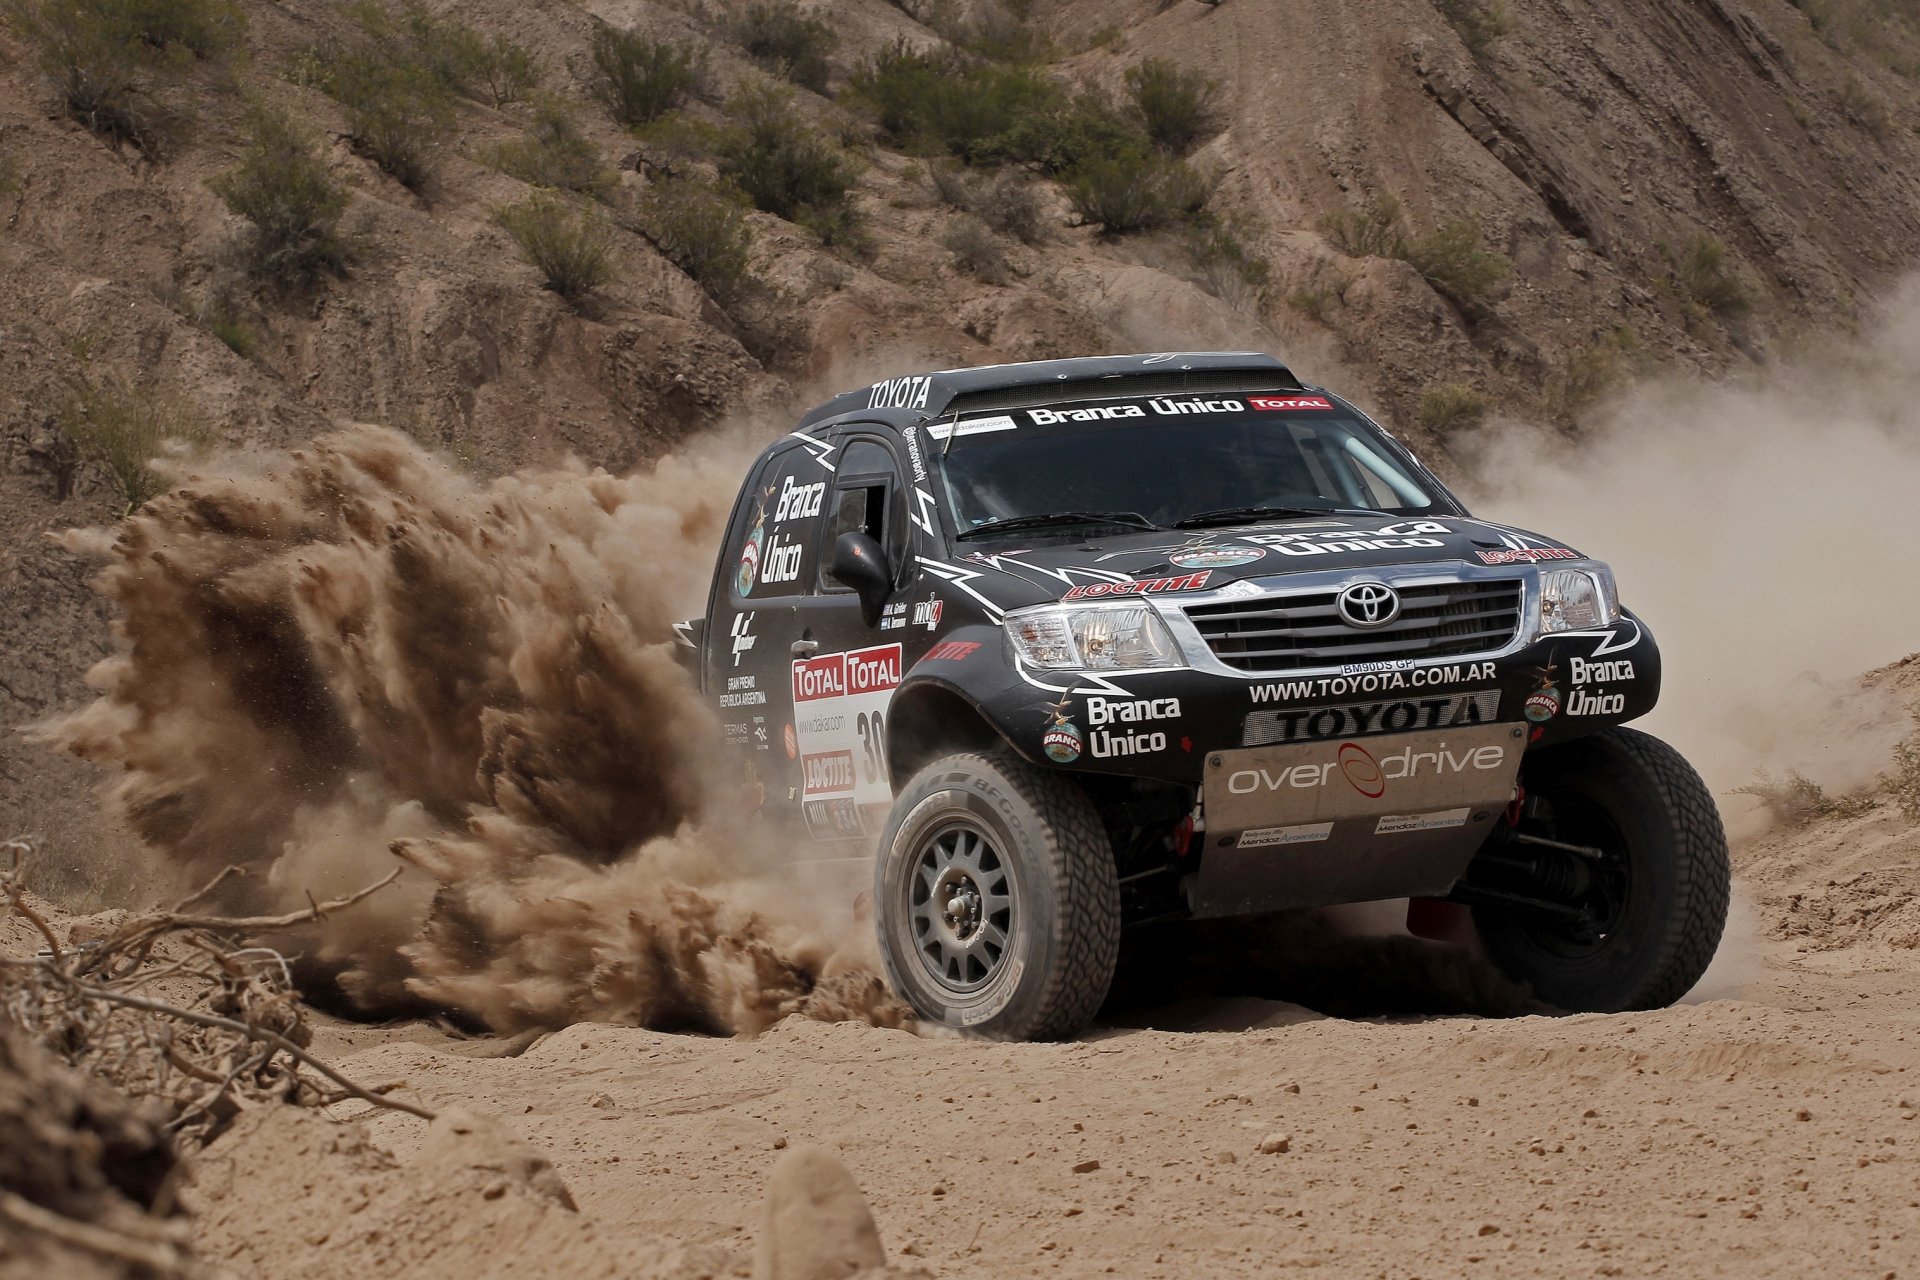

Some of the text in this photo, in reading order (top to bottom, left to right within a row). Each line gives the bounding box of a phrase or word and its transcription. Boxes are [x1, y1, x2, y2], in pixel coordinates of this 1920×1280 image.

[867, 376, 932, 409] TOYOTA
[1250, 399, 1331, 408] TOTAL
[1027, 397, 1244, 426] Branca Único
[774, 475, 826, 522] Branca
[1237, 521, 1452, 545] Branca
[761, 525, 802, 583] Único
[1173, 550, 1261, 562] BRANCA
[1474, 549, 1579, 565] LOCTITE
[1062, 570, 1213, 600] LOCTITE
[795, 665, 843, 696] TOTAL
[848, 657, 899, 689] TOTAL
[1343, 659, 1412, 673] BM90DS GP
[1570, 657, 1635, 684] Branca
[1250, 662, 1497, 703] WWW.TOYOTA.COM.AR
[1086, 697, 1181, 725] Branca
[1525, 696, 1557, 714] BRANCA
[1566, 685, 1625, 716] Único
[1277, 695, 1480, 739] TOYOTA
[1043, 732, 1081, 753] BRANCA
[1090, 725, 1167, 758] Único
[807, 755, 851, 789] LOCTITE
